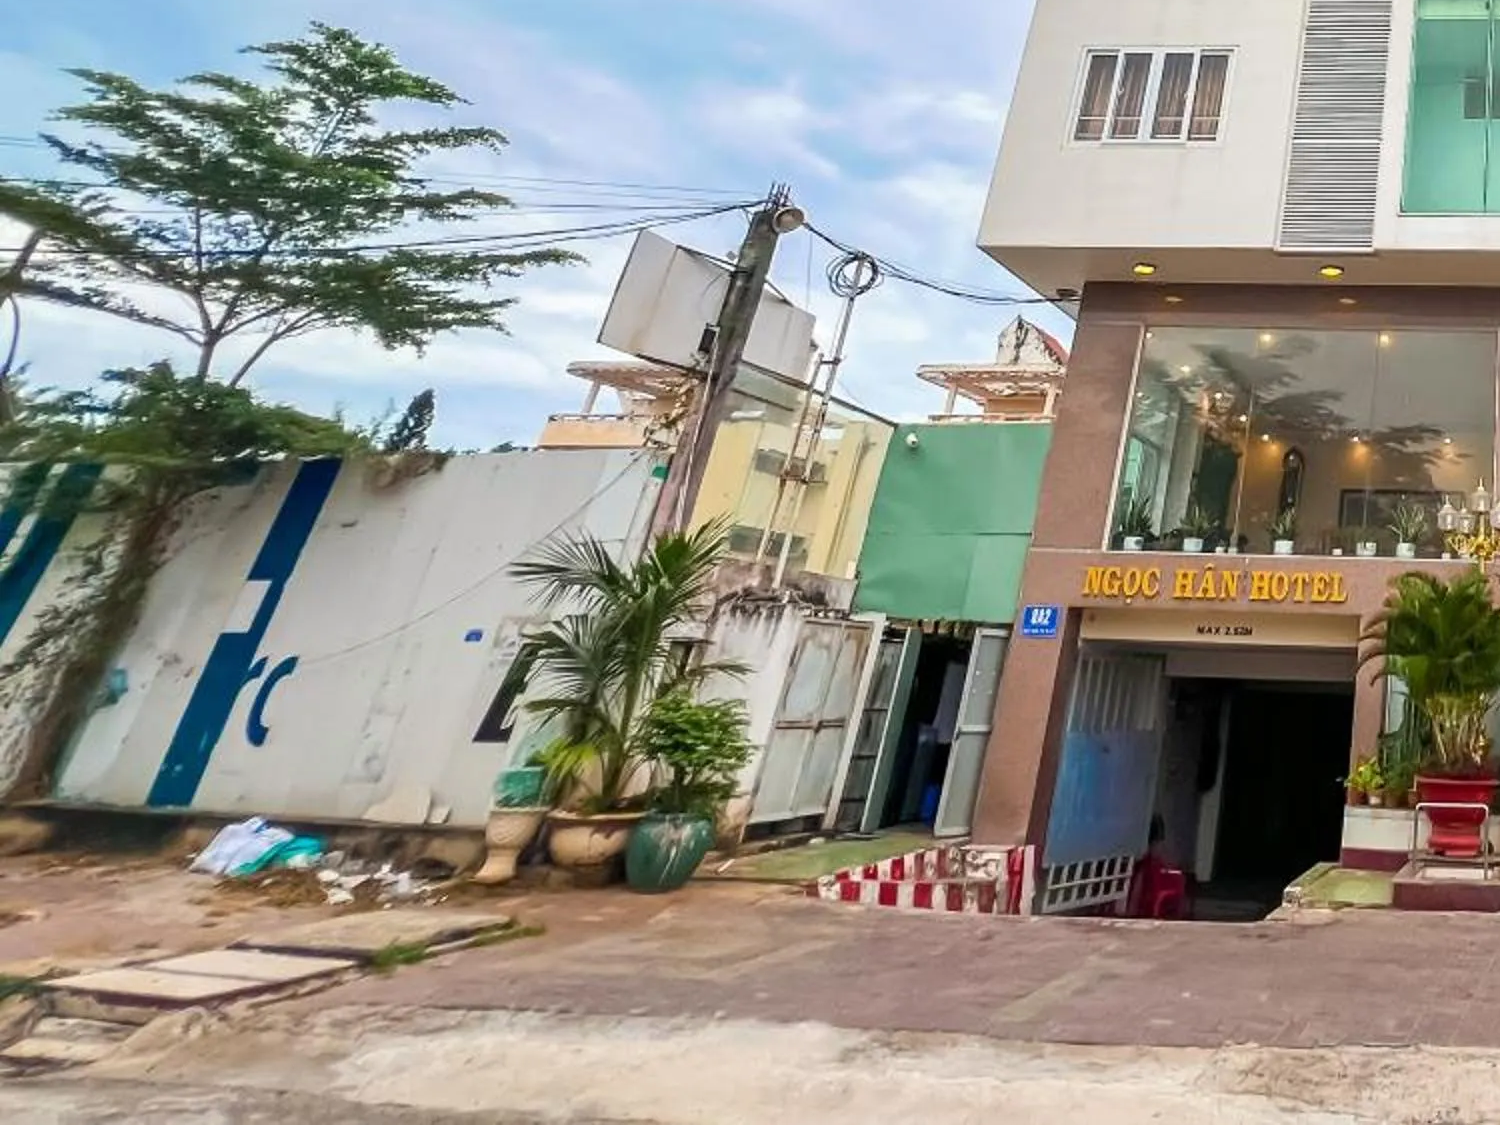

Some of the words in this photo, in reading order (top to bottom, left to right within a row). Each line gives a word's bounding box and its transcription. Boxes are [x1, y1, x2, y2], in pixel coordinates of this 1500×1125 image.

[1082, 566, 1161, 604] NGỌC
[1173, 562, 1239, 600] HÂN
[1249, 570, 1348, 603] HOTEL
[1197, 625, 1221, 635] MAX
